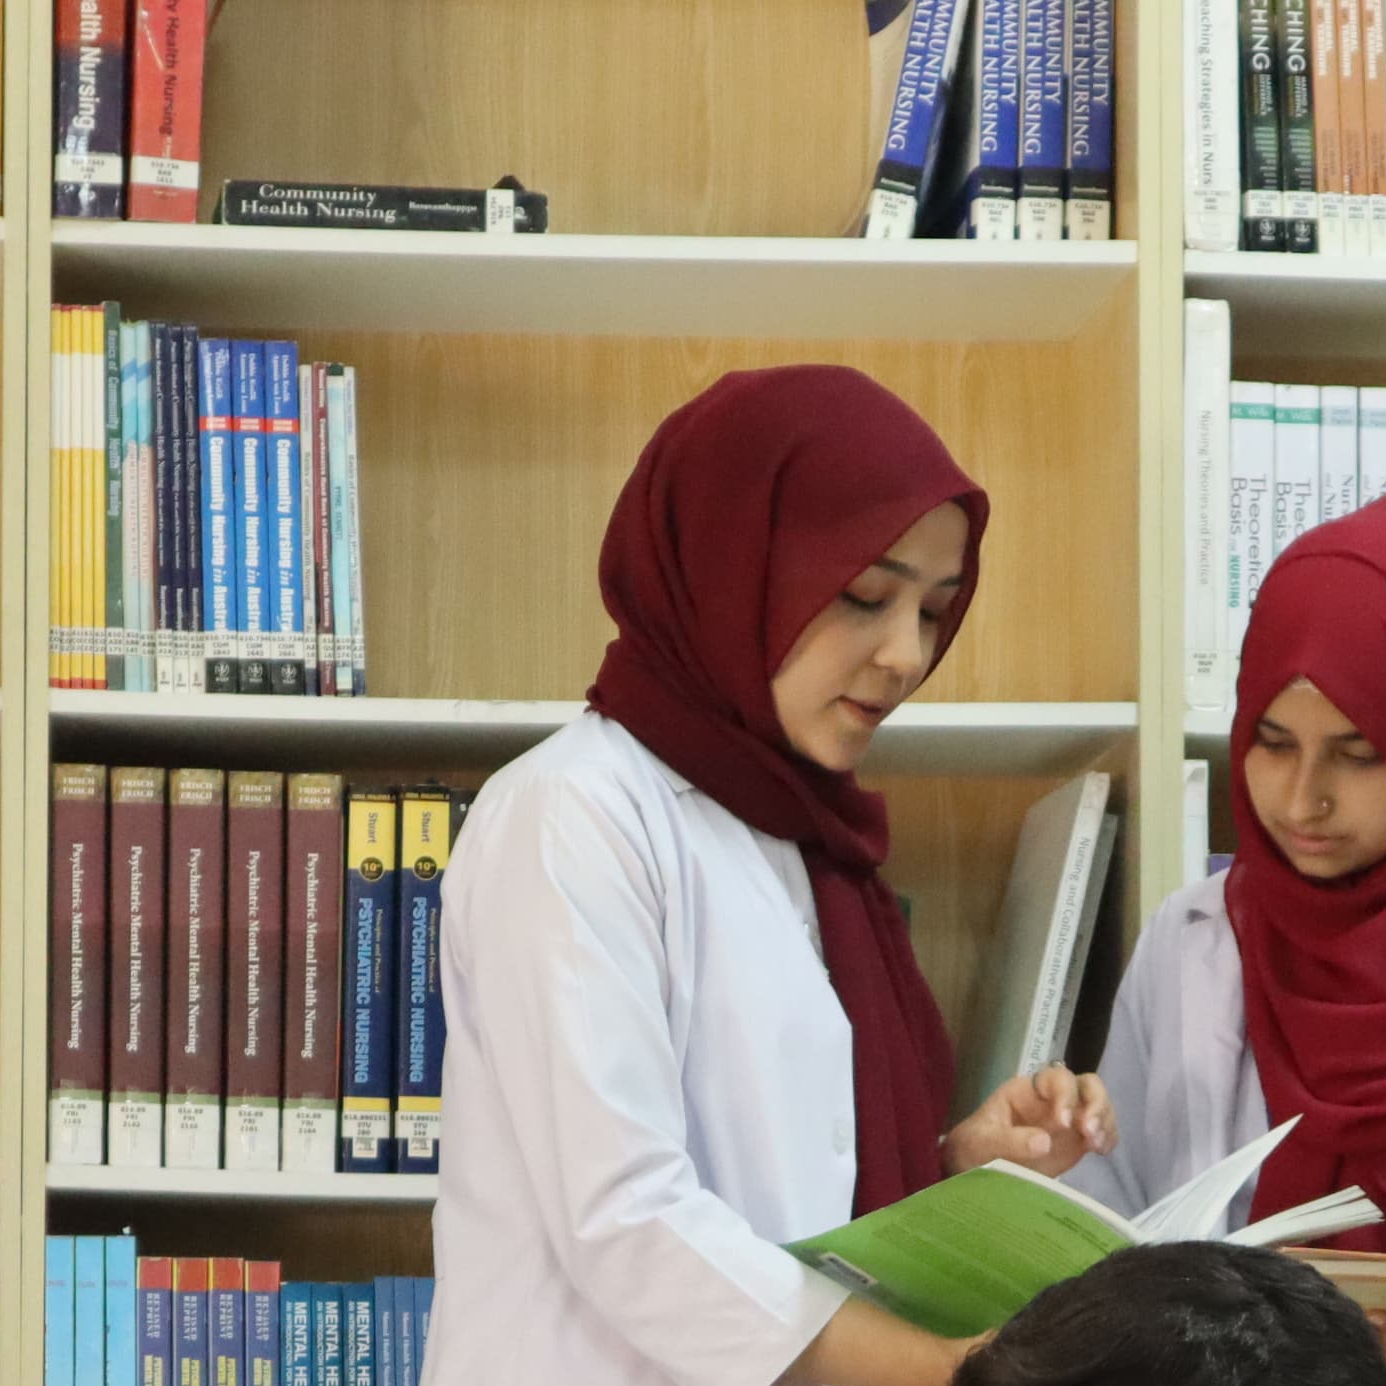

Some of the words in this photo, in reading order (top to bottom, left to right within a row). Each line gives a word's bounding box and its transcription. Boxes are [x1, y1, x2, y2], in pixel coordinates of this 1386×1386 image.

[166, 17, 180, 68] Health
[159, 74, 178, 135] Nursing
[241, 200, 308, 217] Health
[316, 202, 396, 223] Nursing
[259, 184, 376, 207] Community
[1197, 410, 1213, 456] Nursing
[1200, 459, 1212, 509] Theories
[1230, 477, 1248, 535] Basis
[1200, 512, 1213, 534] and
[1276, 482, 1293, 540] Basis
[1200, 539, 1212, 585] Practice
[367, 813, 379, 843] Stuart
[420, 812, 432, 842] Stuart
[70, 843, 83, 910] Psychiatric
[129, 846, 142, 912] Psychiatric
[188, 848, 201, 914] Psychiatric
[1070, 836, 1091, 880] Nursing
[247, 851, 260, 917] Psychiatric
[306, 853, 320, 918] Psychiatric
[1065, 884, 1080, 906] and
[71, 912, 82, 954] Mental
[130, 915, 141, 956] Mental
[189, 917, 200, 958] Mental
[248, 920, 259, 961] Mental
[306, 922, 318, 963] Mental
[357, 898, 373, 1003] PSYCHIATRIC
[411, 897, 427, 1003] PSYCHIATRIC
[1046, 909, 1076, 985] Collaborative
[70, 957, 82, 996] Health
[129, 960, 141, 999] Health
[188, 962, 200, 1002] Health
[247, 964, 259, 1004] Health
[305, 966, 317, 1006] Health
[67, 1000, 81, 1049] Nursing
[126, 1002, 139, 1052] Nursing
[185, 1005, 199, 1054] Nursing
[245, 1007, 258, 1056] Nursing
[301, 1009, 316, 1058] Nursing
[1036, 988, 1056, 1035] Practice
[354, 1008, 370, 1083] NURSING
[410, 1008, 425, 1082] NURSING
[294, 1300, 308, 1360] MENTAL
[325, 1300, 339, 1360] MENTAL
[357, 1300, 371, 1360] MENTAL
